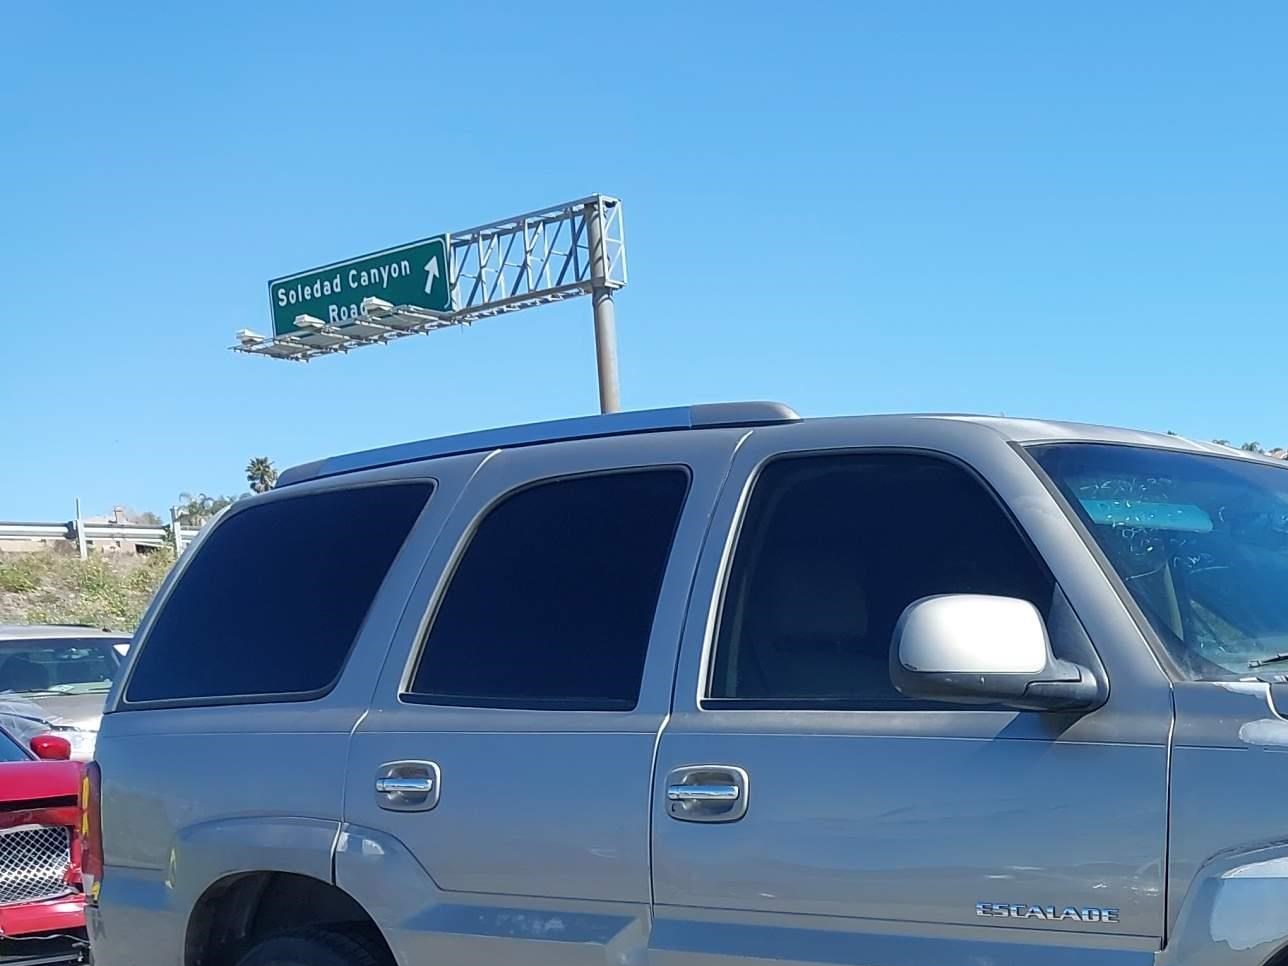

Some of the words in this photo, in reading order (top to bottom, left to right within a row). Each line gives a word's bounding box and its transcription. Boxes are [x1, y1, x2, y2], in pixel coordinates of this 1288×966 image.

[277, 273, 341, 307] Soledad
[348, 259, 410, 289] Canyon
[975, 902, 1121, 923] ESCALADE
